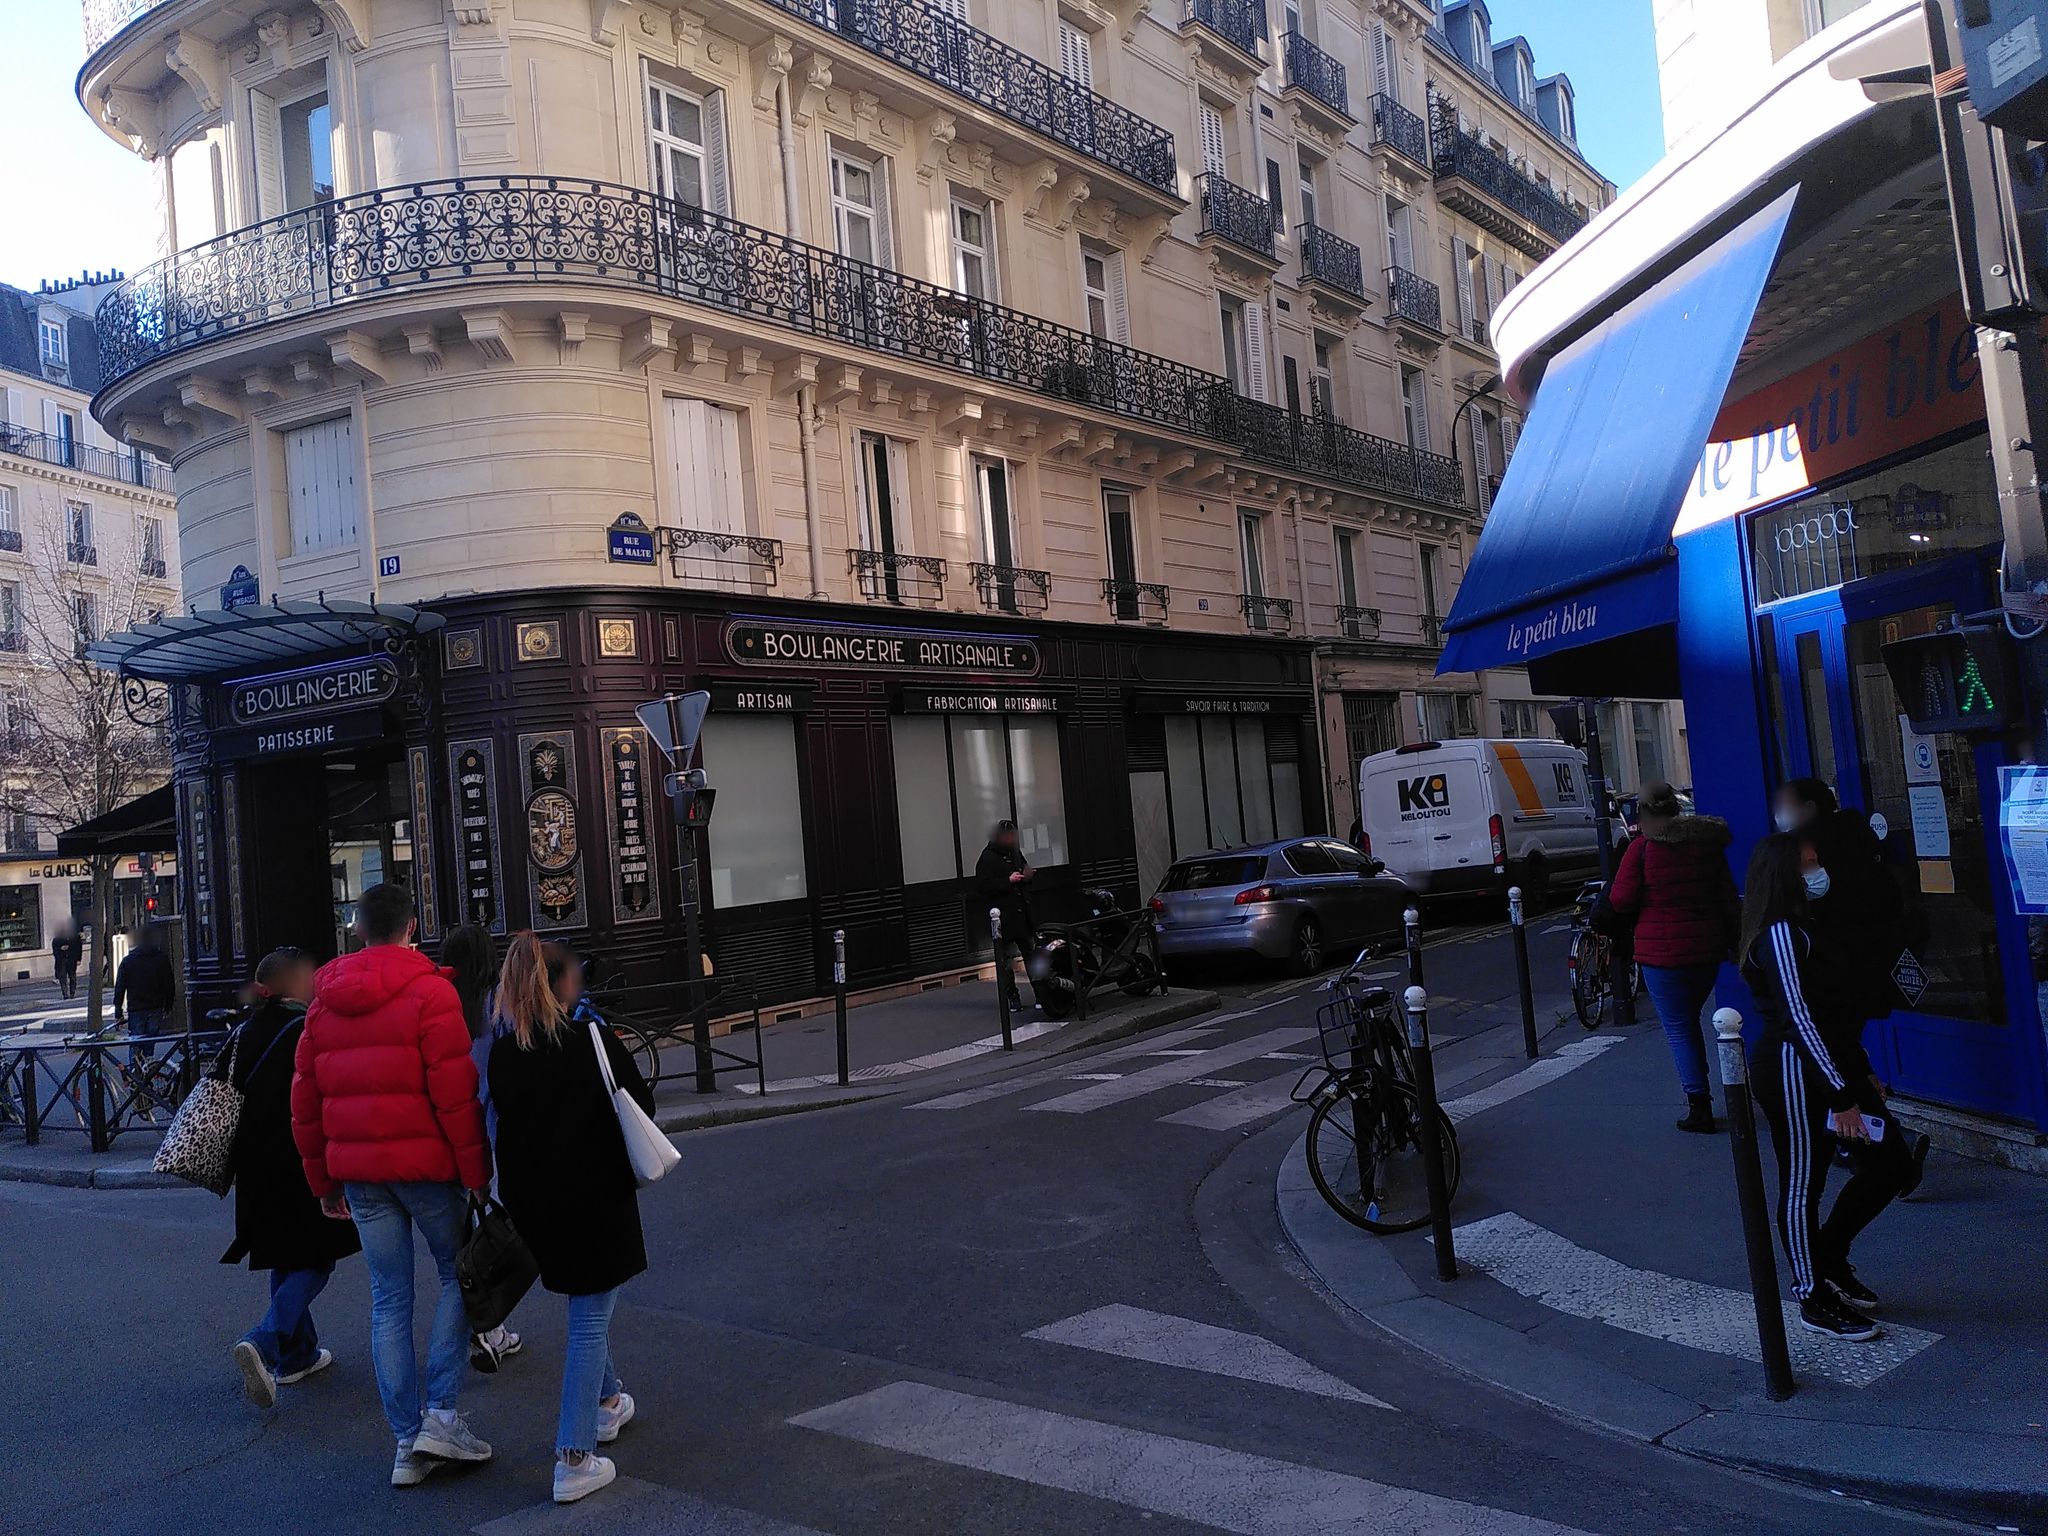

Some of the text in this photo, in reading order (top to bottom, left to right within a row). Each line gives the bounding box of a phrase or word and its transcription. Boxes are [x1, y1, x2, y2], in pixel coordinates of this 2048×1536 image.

[1746, 363, 1863, 501] petit
[1885, 310, 1983, 420] ble
[623, 536, 640, 546] RUE
[612, 547, 652, 558] DE MALTE
[383, 557, 398, 575] 19
[232, 588, 244, 597] RUE
[1507, 602, 1597, 655] le petit bleu
[764, 632, 1015, 668] BOULANGERIE ARTISANALE
[245, 668, 379, 715] BOULANGERIE
[737, 692, 793, 709] ARTISAN
[927, 696, 1058, 711] FABRICATION ARTISANALE
[1185, 700, 1270, 712] SAVOIR FAIRE & TRADITION
[258, 725, 336, 752] PATISSERIE
[1897, 974, 1924, 987] CLUIZEL
